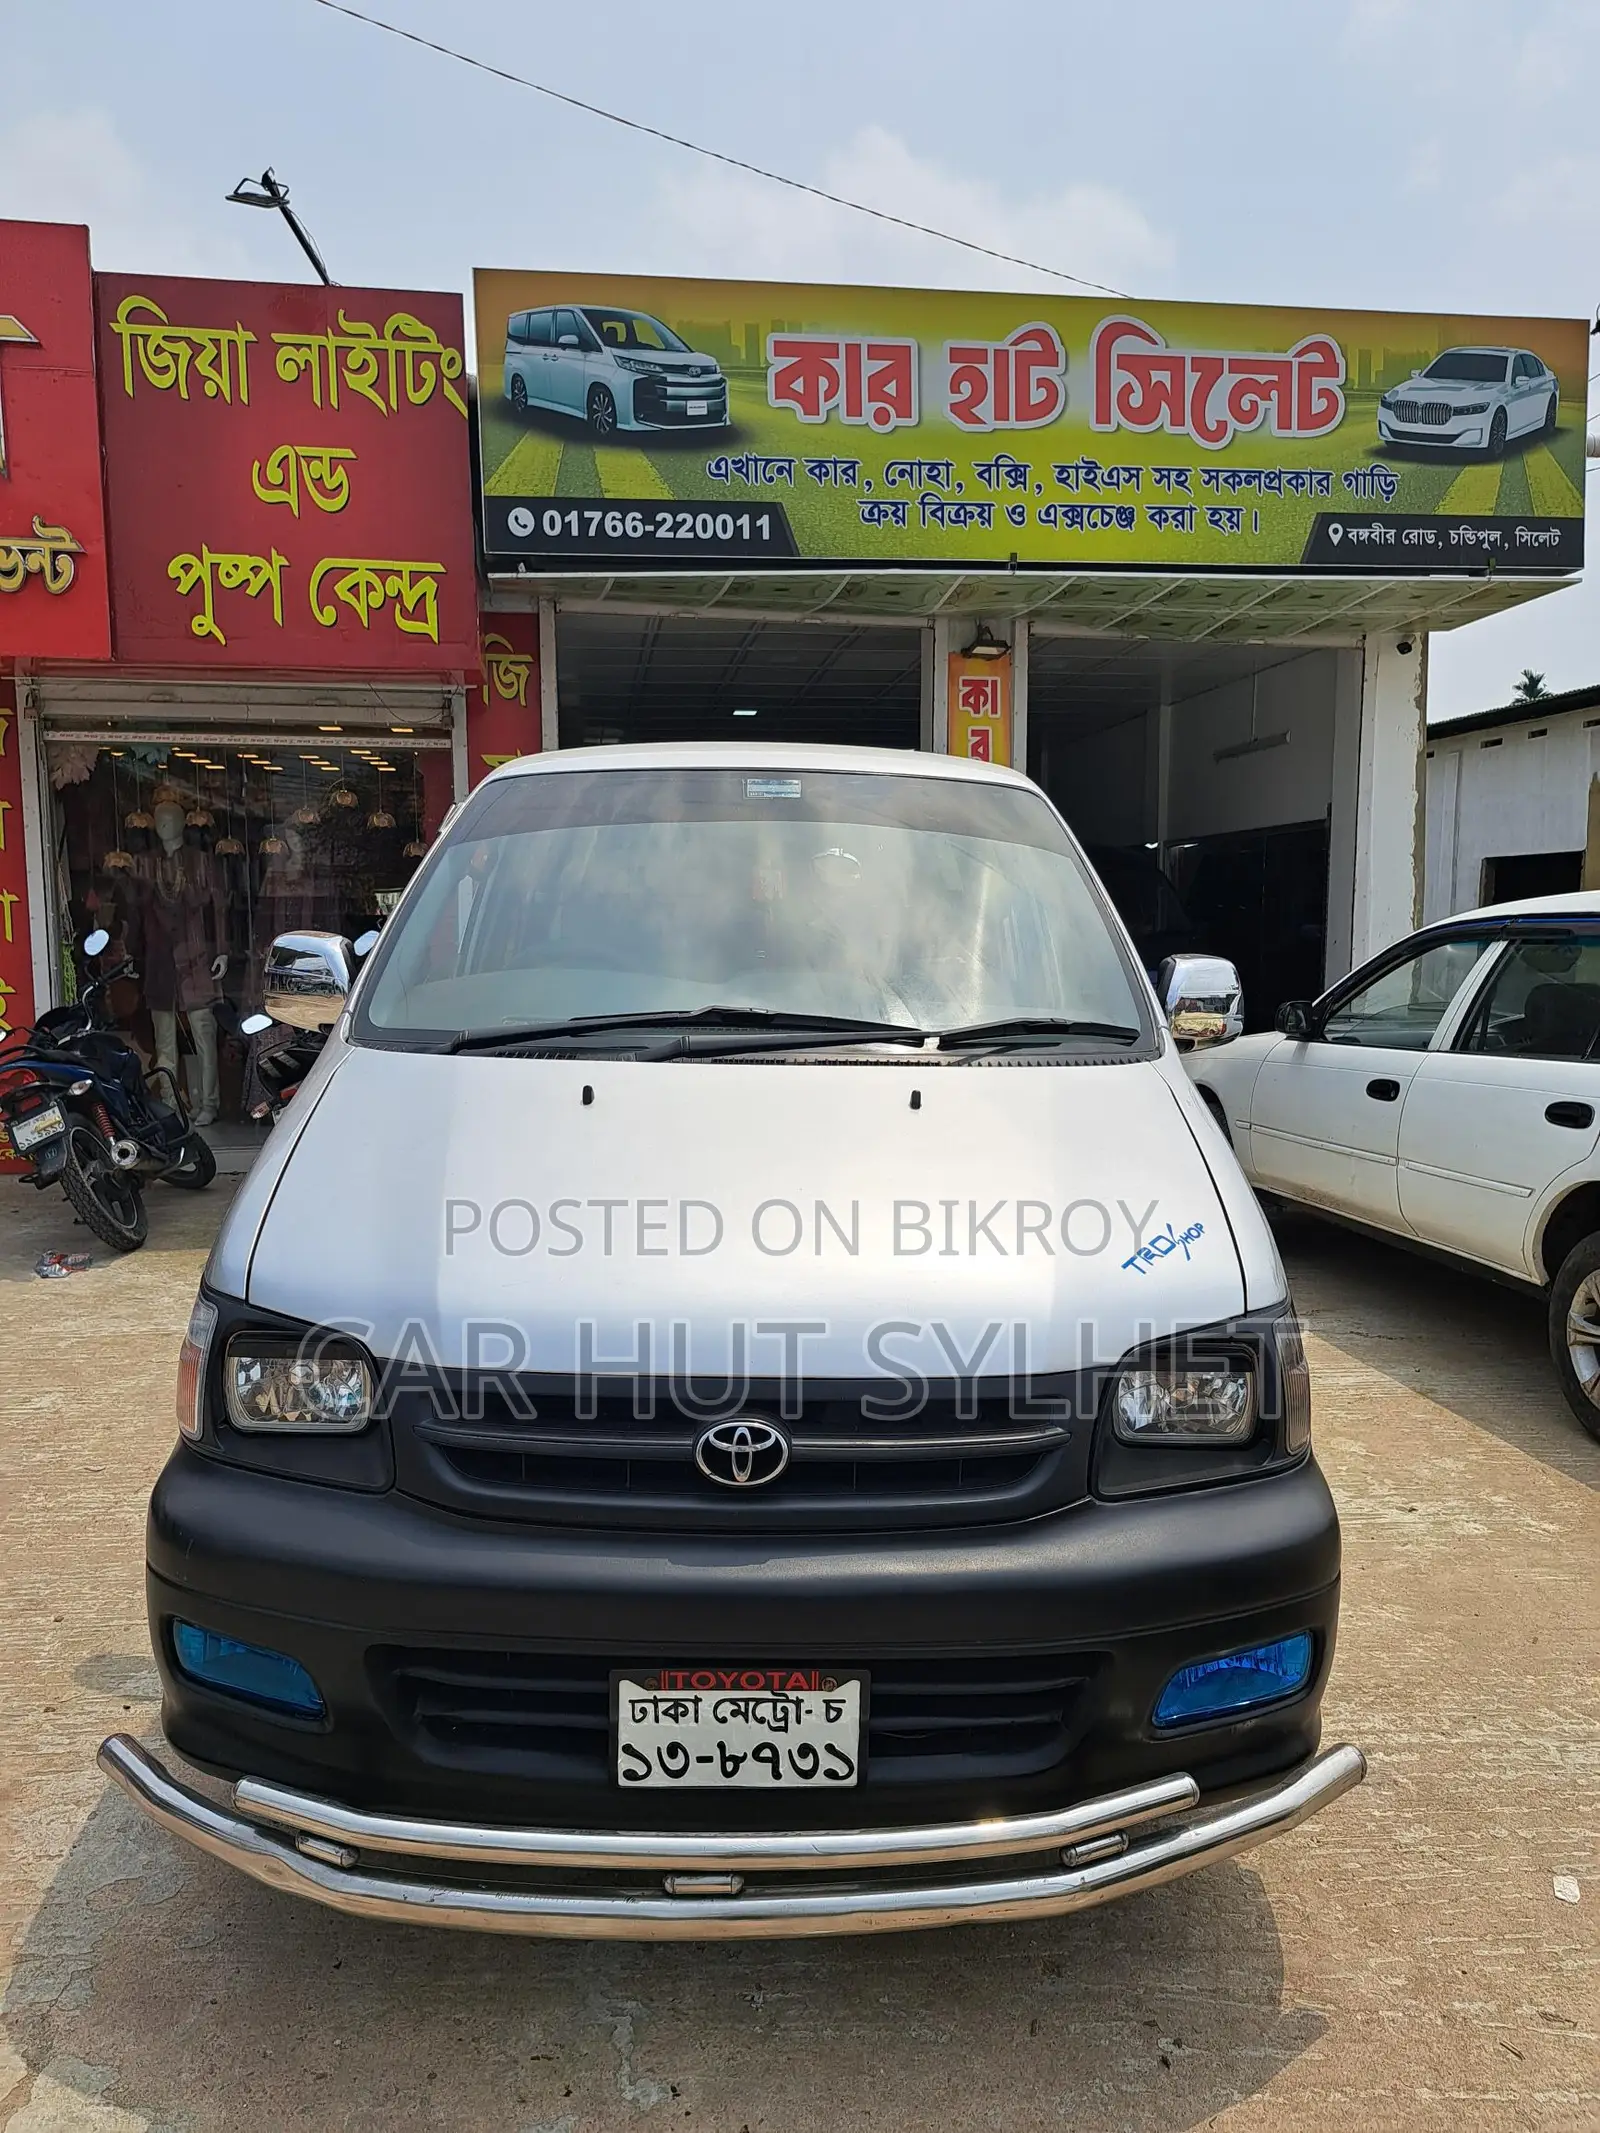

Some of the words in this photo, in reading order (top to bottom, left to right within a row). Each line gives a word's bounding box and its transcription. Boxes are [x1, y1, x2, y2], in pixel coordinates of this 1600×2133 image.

[110, 295, 258, 405] জিয়া
[271, 309, 468, 419] লাইটিং
[769, 335, 916, 430] কার
[945, 324, 1063, 428] হাট
[1092, 318, 1343, 447] সিলেট
[253, 445, 357, 519] এন্ড
[707, 455, 796, 485] এখানে
[1053, 457, 1143, 494] হাইএস
[1151, 467, 1193, 496] সহ
[1344, 463, 1400, 501] গাড়ি
[542, 510, 771, 541] 01766-220011
[858, 500, 910, 529] ক্রয়
[918, 493, 995, 530] বিক্রয়
[1005, 503, 1028, 527] ও
[1146, 504, 1199, 532] করা
[1347, 523, 1397, 547] বঙ্গবীর
[1515, 526, 1561, 548] সিলেট
[168, 543, 290, 646] পুষ্প
[310, 557, 446, 644] কেন্দ্র
[1121, 1235, 1177, 1275] TRD
[669, 1671, 810, 1691] TOYOTA
[628, 1694, 703, 1724] ঢাকা
[822, 1698, 846, 1723] চ
[620, 1740, 855, 1781] ১৩-৮৭৩১
